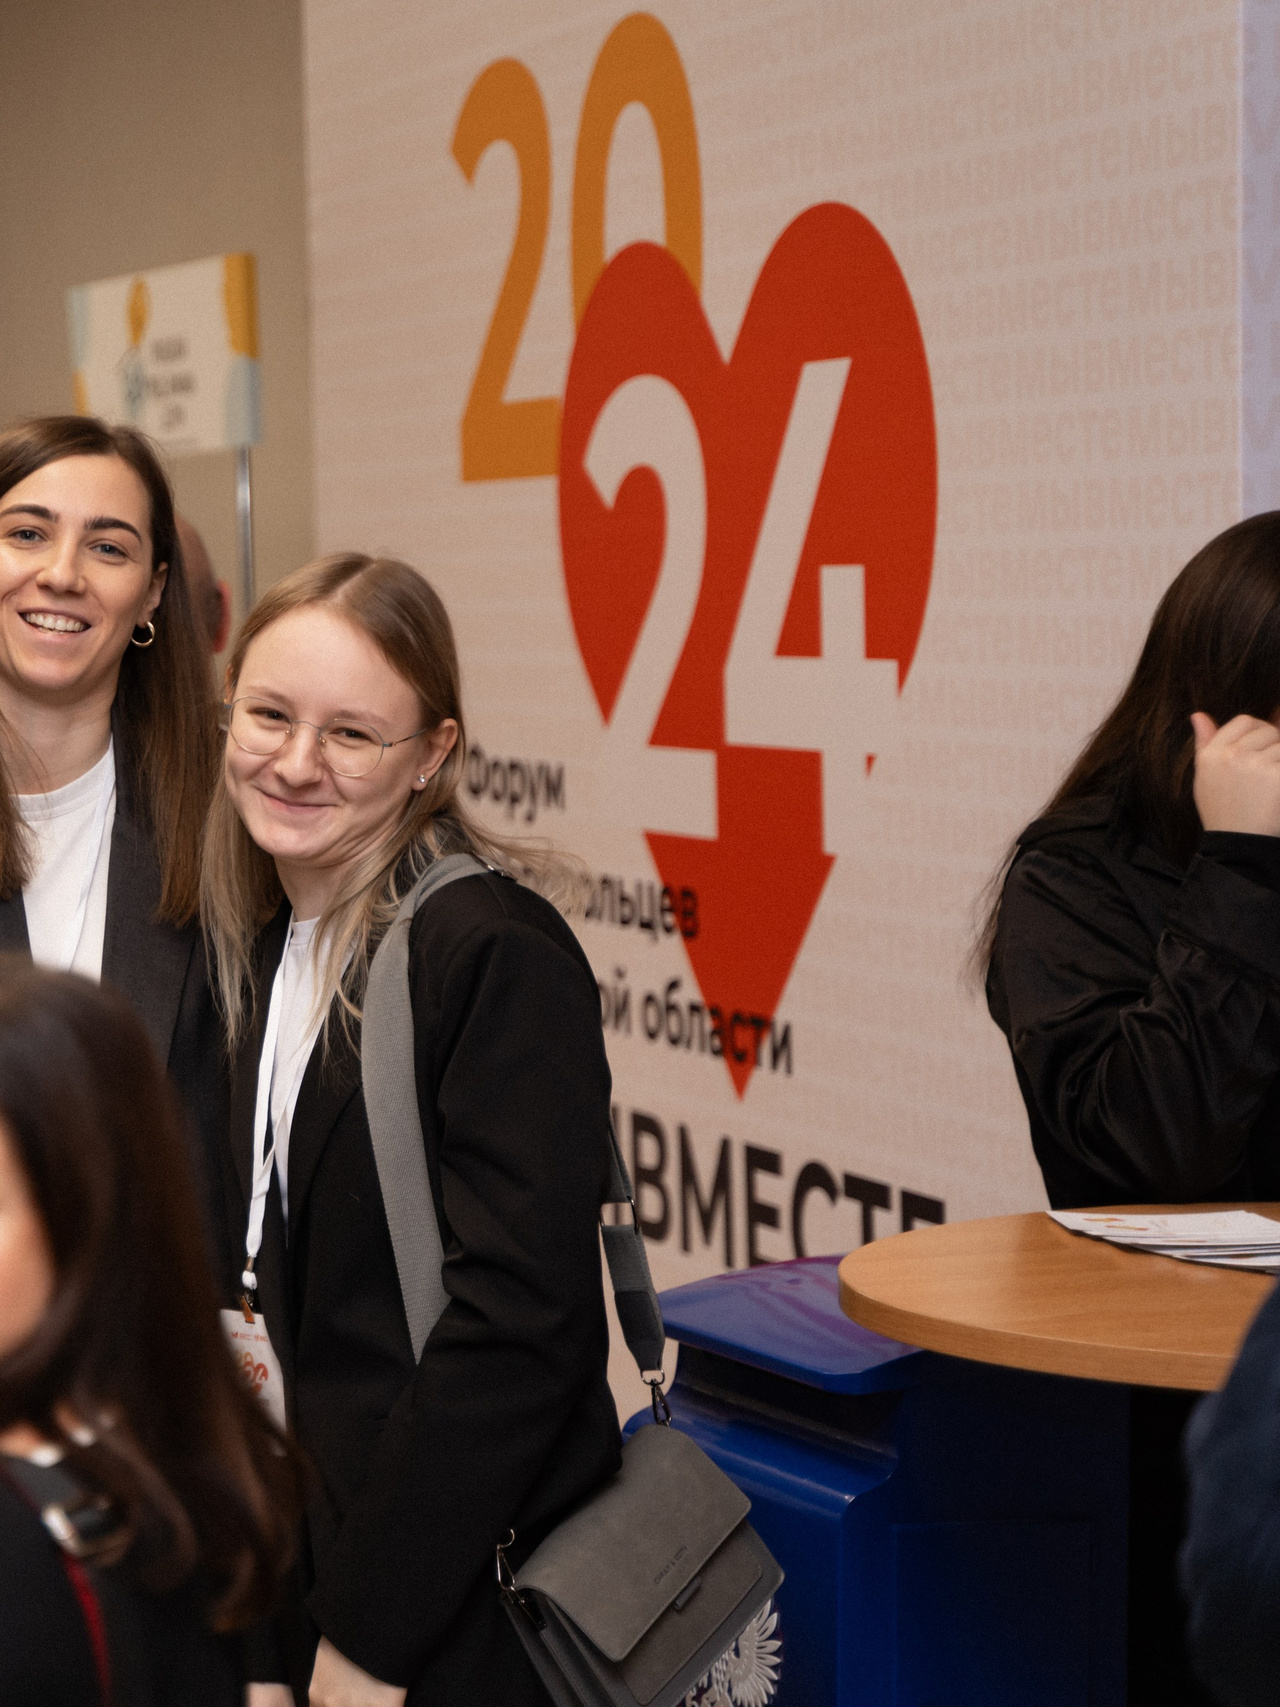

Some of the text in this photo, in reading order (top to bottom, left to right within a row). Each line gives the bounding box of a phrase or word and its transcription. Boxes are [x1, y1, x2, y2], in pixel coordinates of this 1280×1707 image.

[449, 12, 703, 483] 20
[582, 357, 902, 858] 24
[463, 744, 567, 824] Форум
[642, 977, 794, 1077] области
